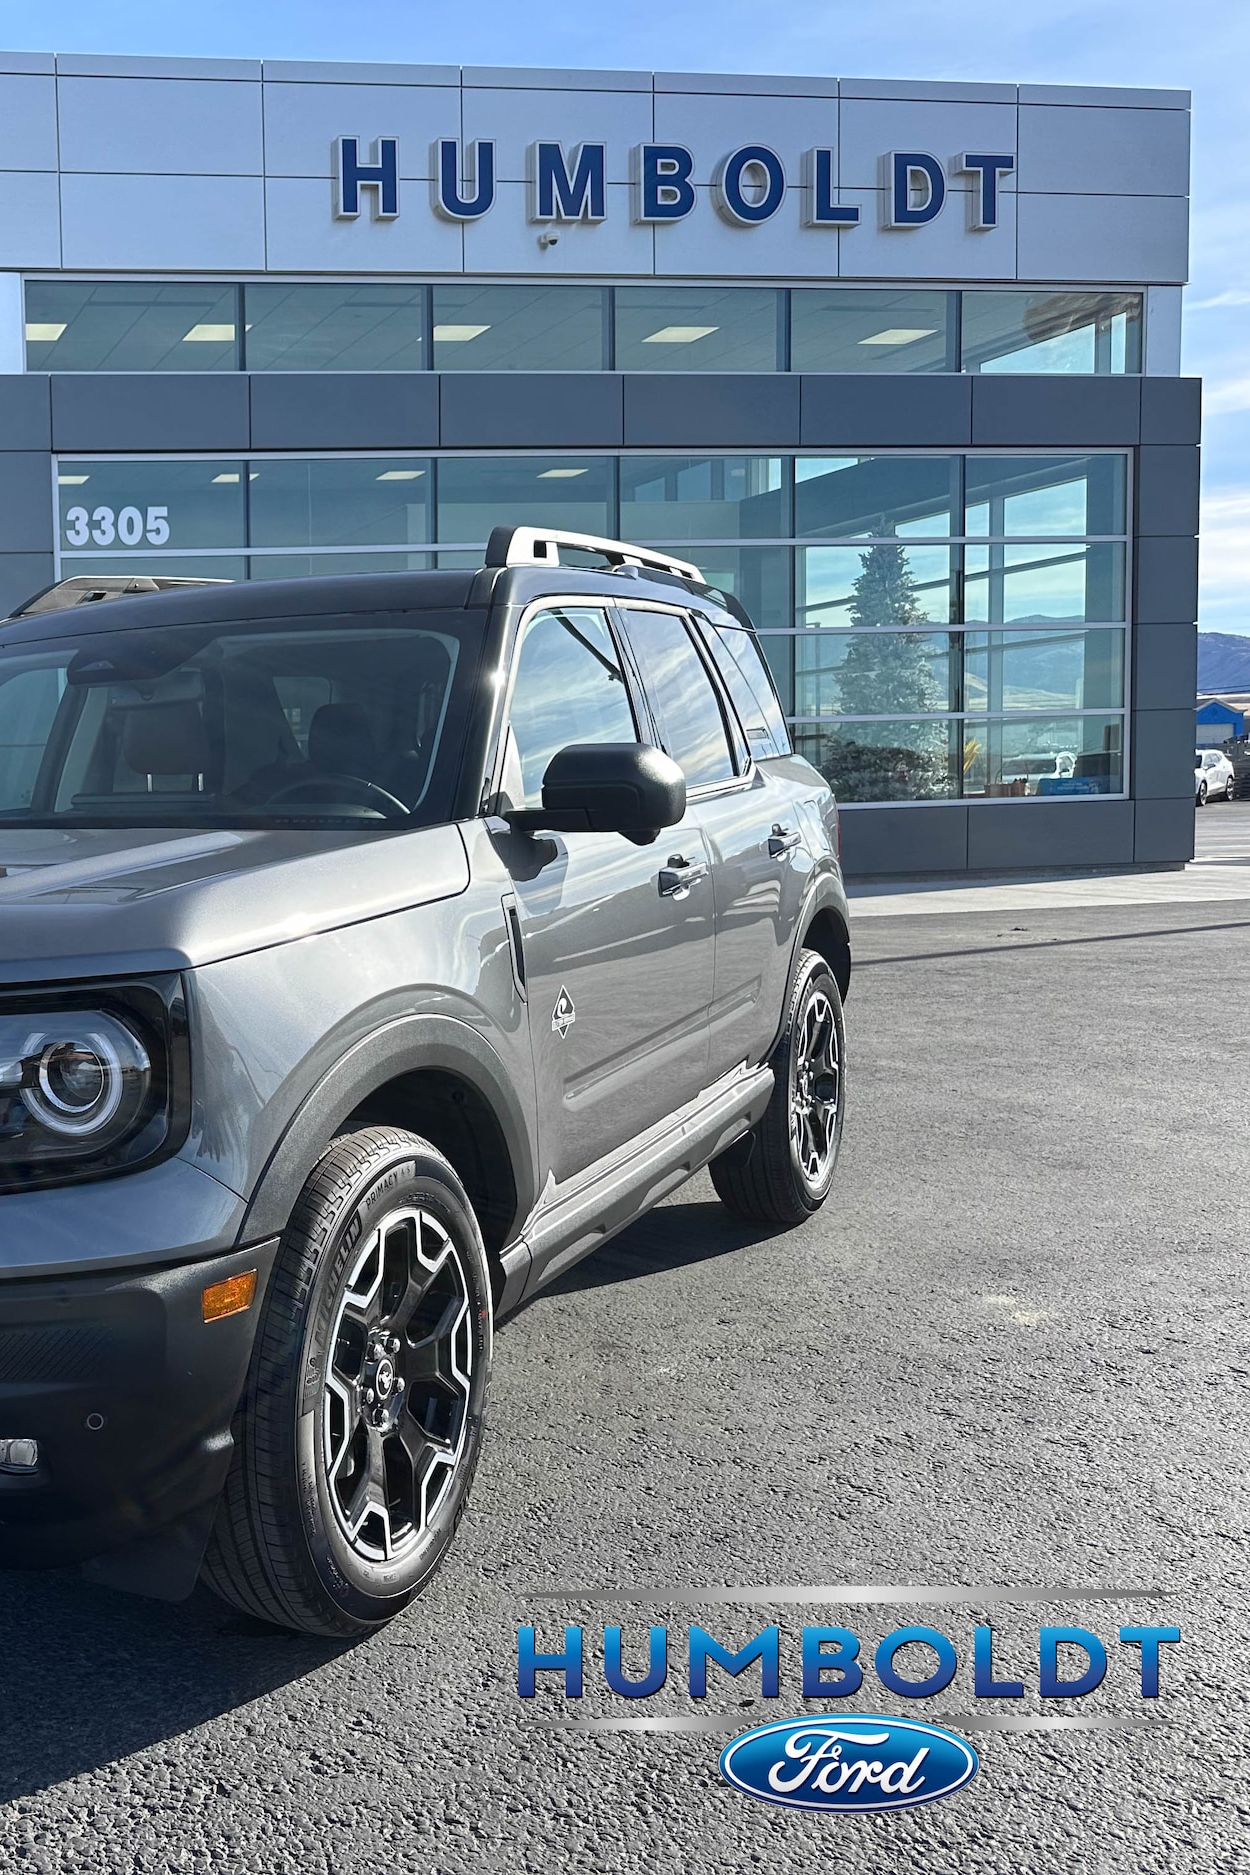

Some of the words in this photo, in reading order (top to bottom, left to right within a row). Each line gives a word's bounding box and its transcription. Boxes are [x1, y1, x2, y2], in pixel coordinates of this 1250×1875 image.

[332, 135, 1017, 232] HUMBOLDT
[65, 506, 170, 546] 3305
[365, 1172, 398, 1210] PRIMACY
